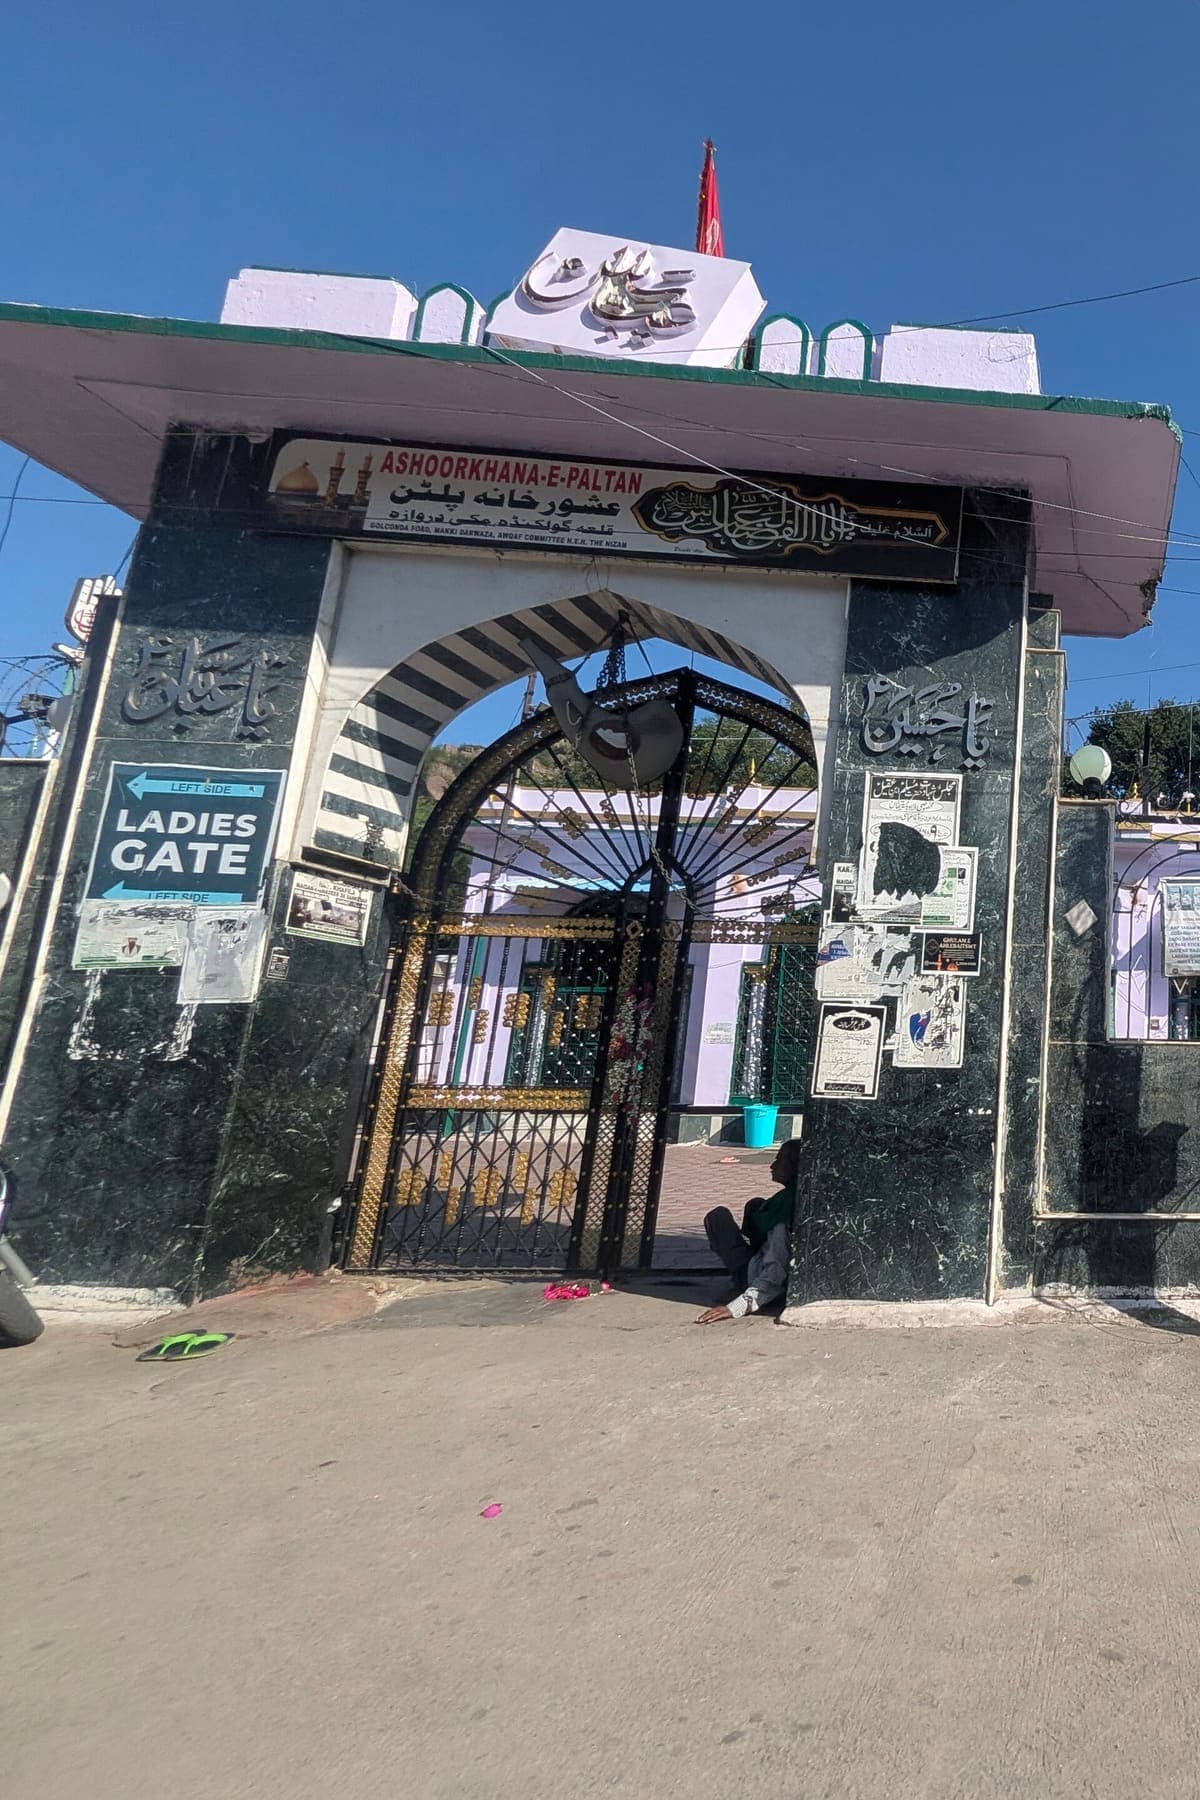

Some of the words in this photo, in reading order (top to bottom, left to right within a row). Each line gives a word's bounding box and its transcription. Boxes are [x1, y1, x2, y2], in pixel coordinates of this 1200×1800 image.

[380, 450, 642, 494] ASHOORKHANA-E-PALTAN
[524, 533, 565, 544] COMMITTEE
[171, 782, 200, 793] LEFT
[203, 783, 232, 794] SIDE
[116, 808, 257, 837] LADIES
[111, 839, 251, 875] GATE
[182, 893, 210, 903] SIDE
